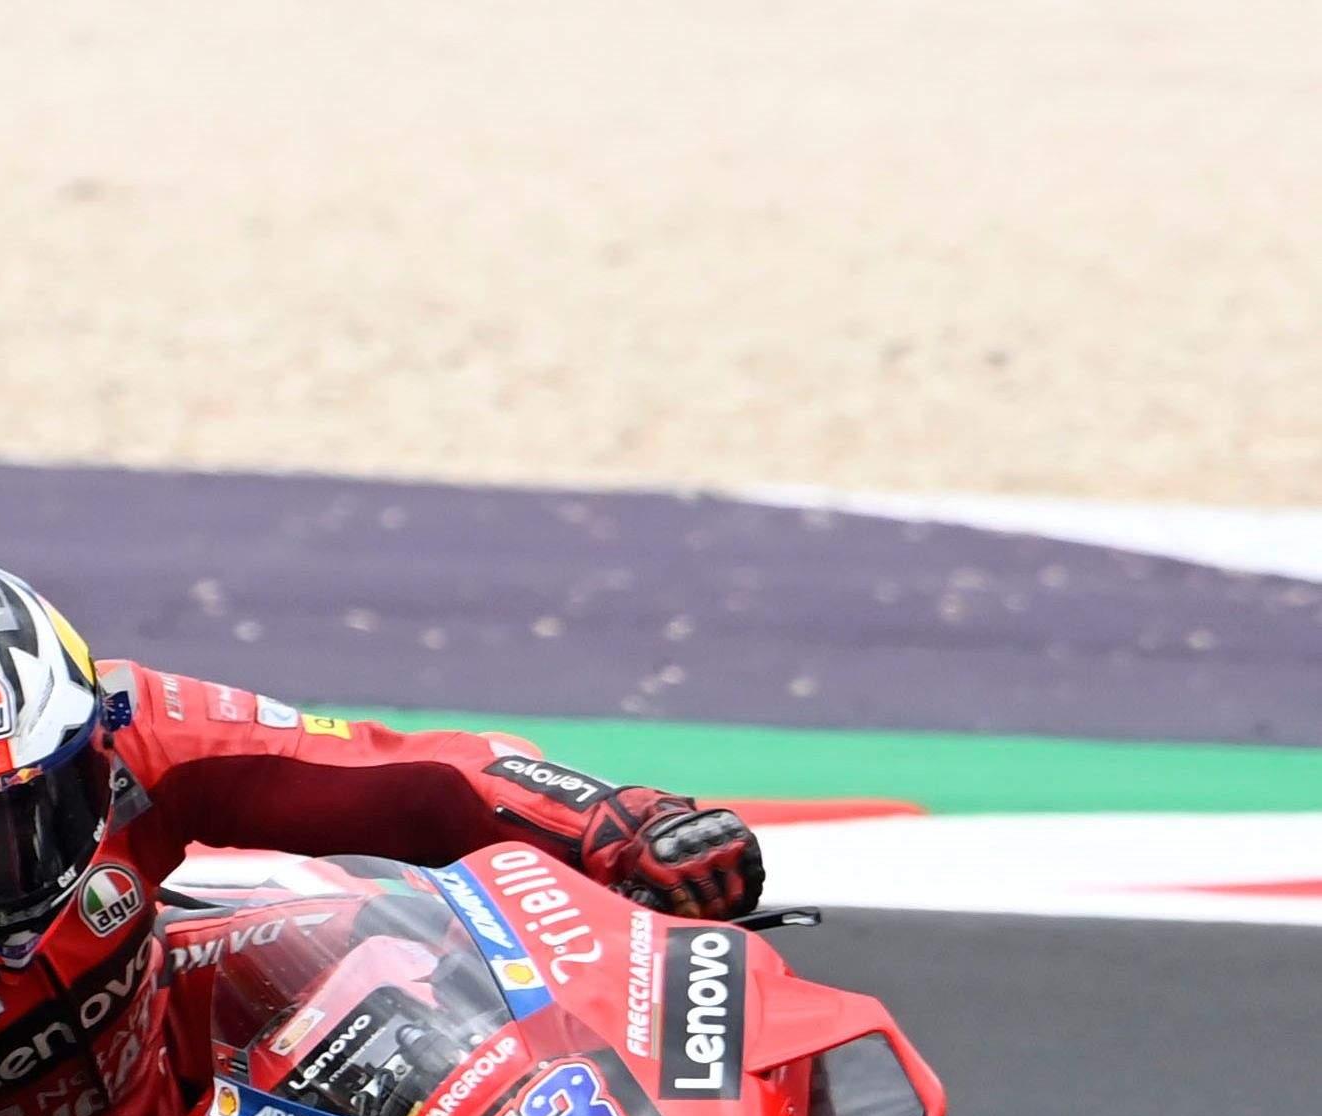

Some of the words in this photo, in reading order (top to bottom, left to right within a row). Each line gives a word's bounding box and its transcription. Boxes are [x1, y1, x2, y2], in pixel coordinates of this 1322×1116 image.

[502, 755, 599, 805] Lenovo
[57, 865, 78, 889] CAT
[95, 887, 139, 928] agv
[627, 909, 654, 1058] FRECCIAROSSA
[674, 932, 731, 1090] Lenovo
[289, 1012, 373, 1090] Lenovo
